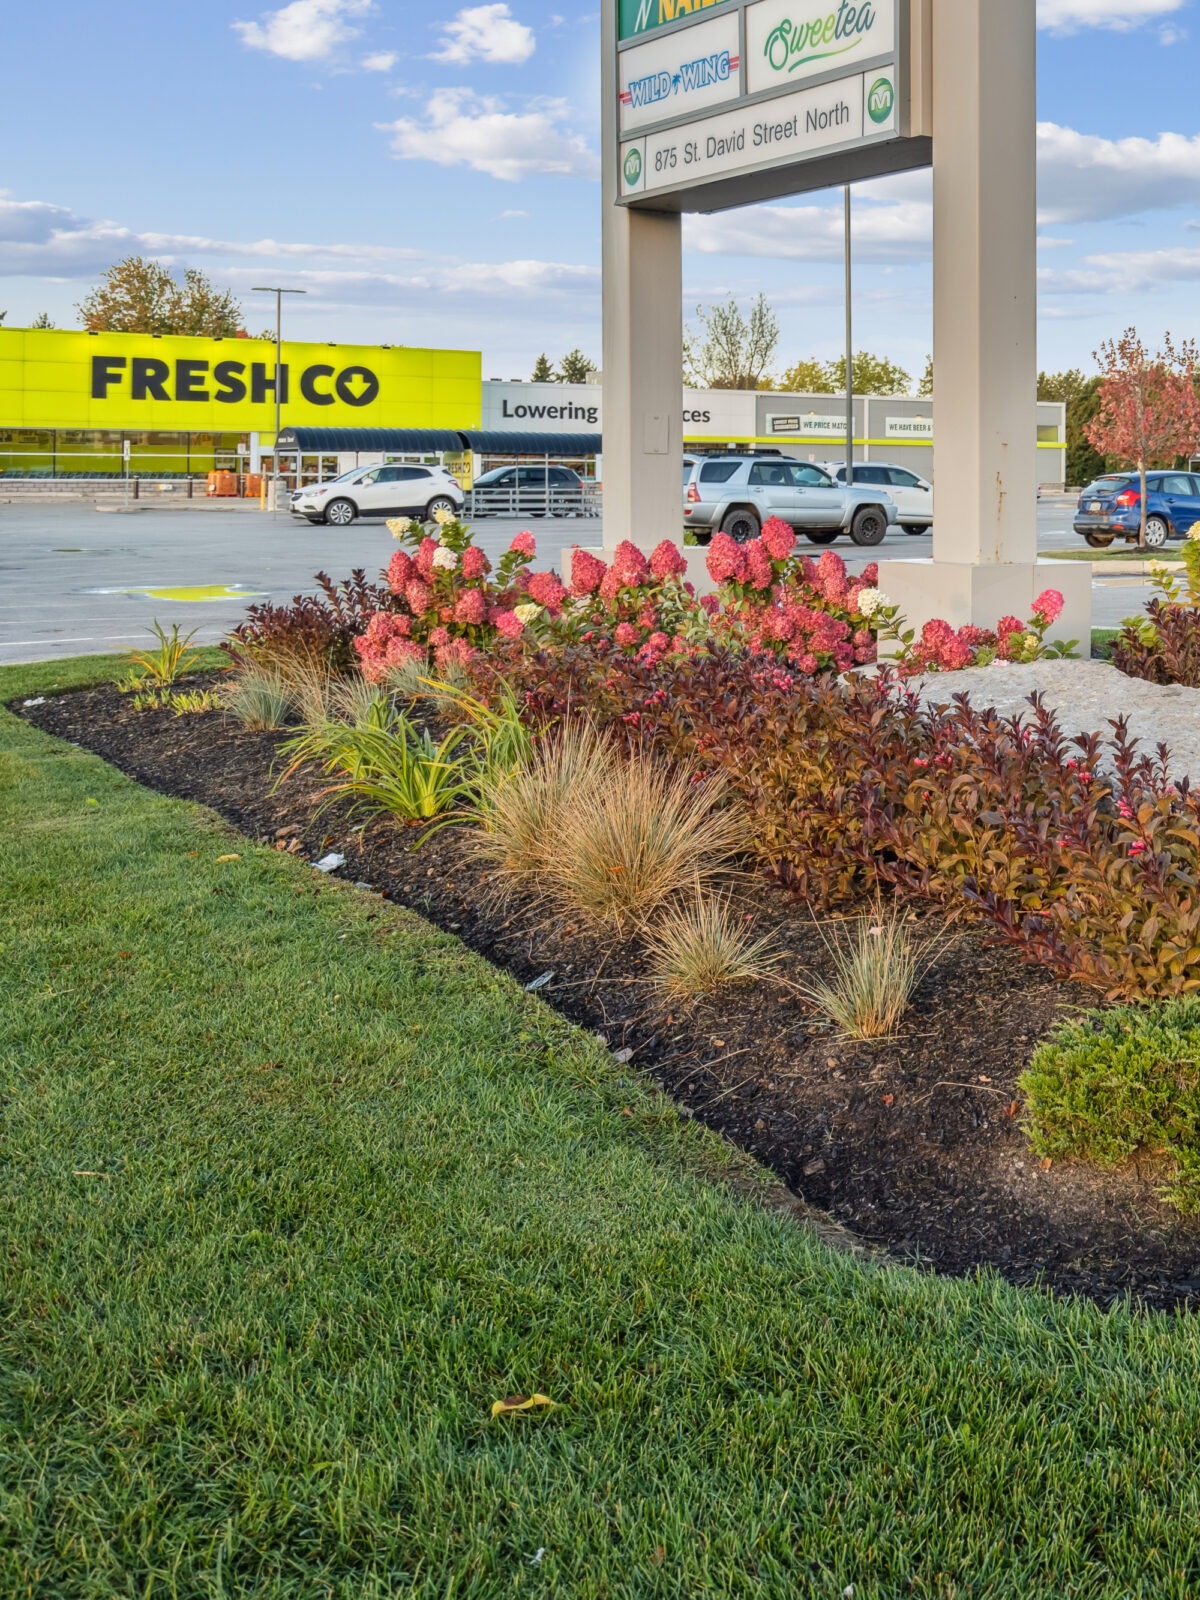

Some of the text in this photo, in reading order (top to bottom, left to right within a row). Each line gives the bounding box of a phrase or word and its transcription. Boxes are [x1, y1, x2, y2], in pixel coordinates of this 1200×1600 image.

[763, 0, 876, 71] Sweetea
[628, 50, 730, 108] WILD WING
[655, 101, 850, 172] 875 St. David Street North
[502, 399, 711, 424] Lowering ces
[803, 421, 813, 429] WE
[814, 421, 831, 430] PRICE
[832, 422, 848, 431] MATC
[889, 423, 898, 431] WE
[899, 423, 912, 431] HAVE
[913, 424, 927, 432] BEER
